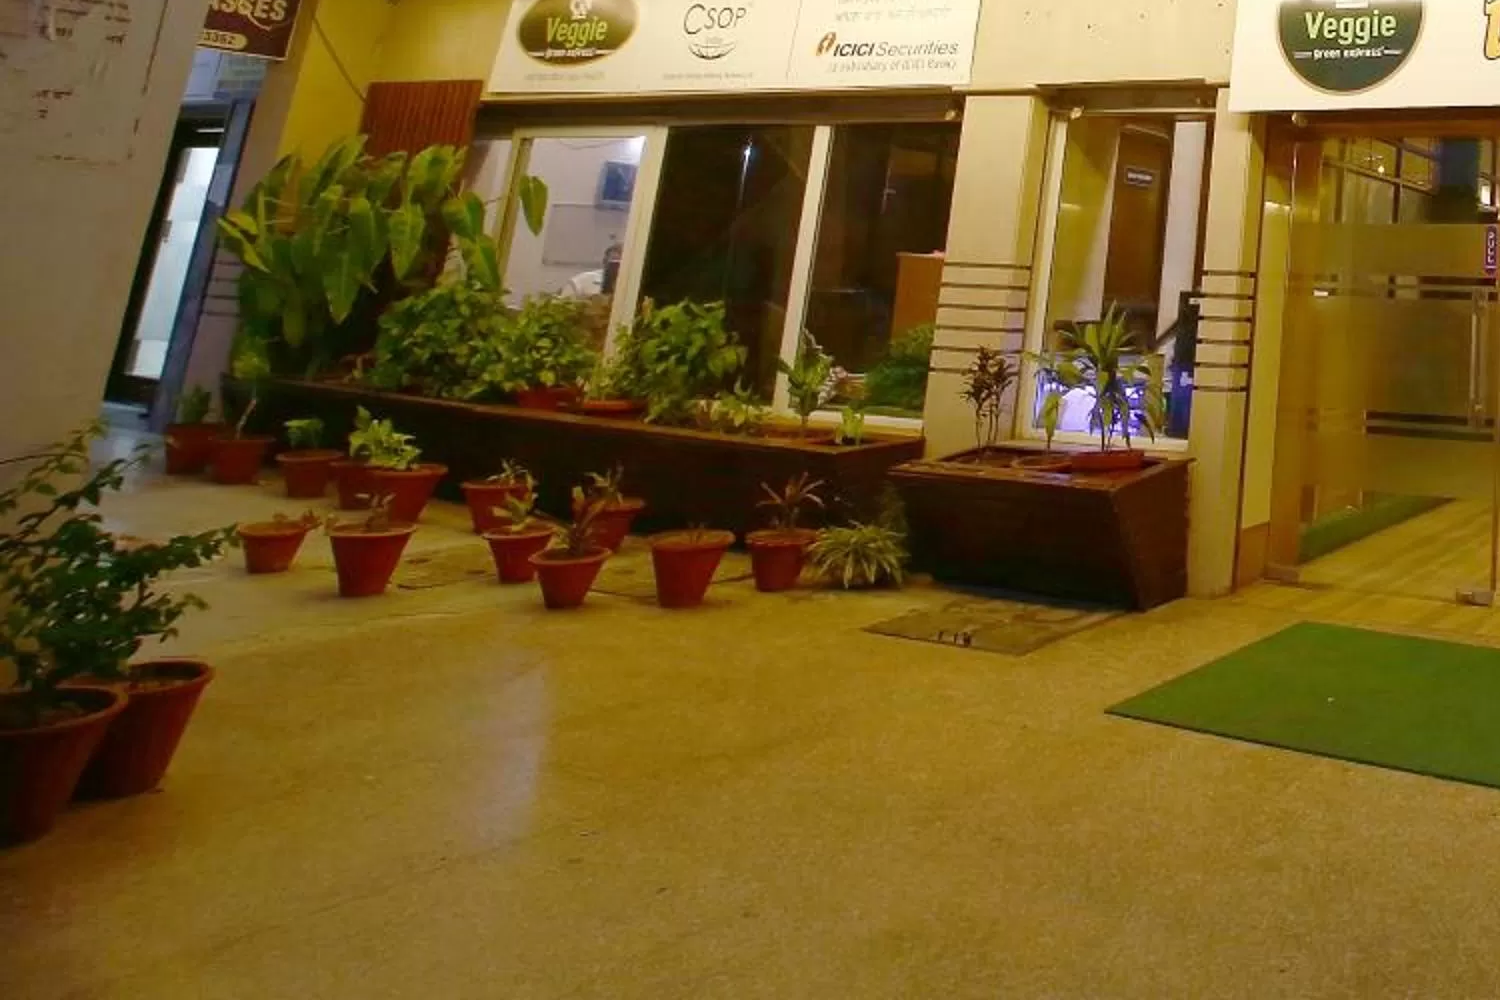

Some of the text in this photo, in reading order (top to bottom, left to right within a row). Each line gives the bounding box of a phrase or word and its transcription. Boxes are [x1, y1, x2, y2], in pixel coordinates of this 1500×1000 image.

[547, 15, 608, 48] Veggie
[1303, 9, 1397, 45] Veggie
[833, 40, 959, 57] ICICI Securities
[1487, 231, 1496, 264] PULL
